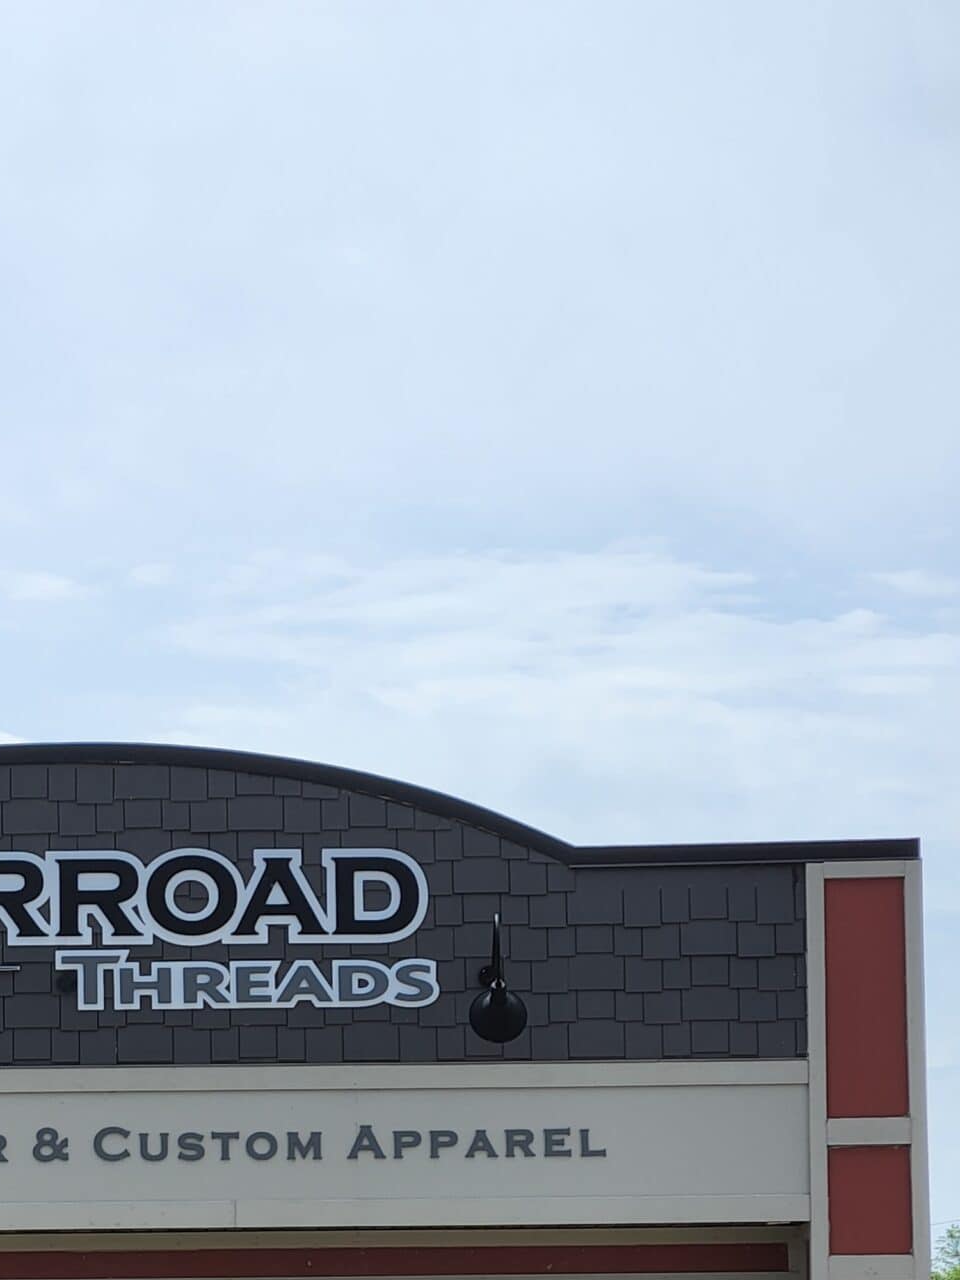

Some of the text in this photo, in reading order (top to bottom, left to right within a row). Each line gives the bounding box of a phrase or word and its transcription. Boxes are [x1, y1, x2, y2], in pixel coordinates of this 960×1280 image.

[55, 949, 440, 1011] THREADS
[32, 1127, 69, 1163] &
[93, 1126, 323, 1161] CUSTOM
[347, 1125, 607, 1160] APPAREL
